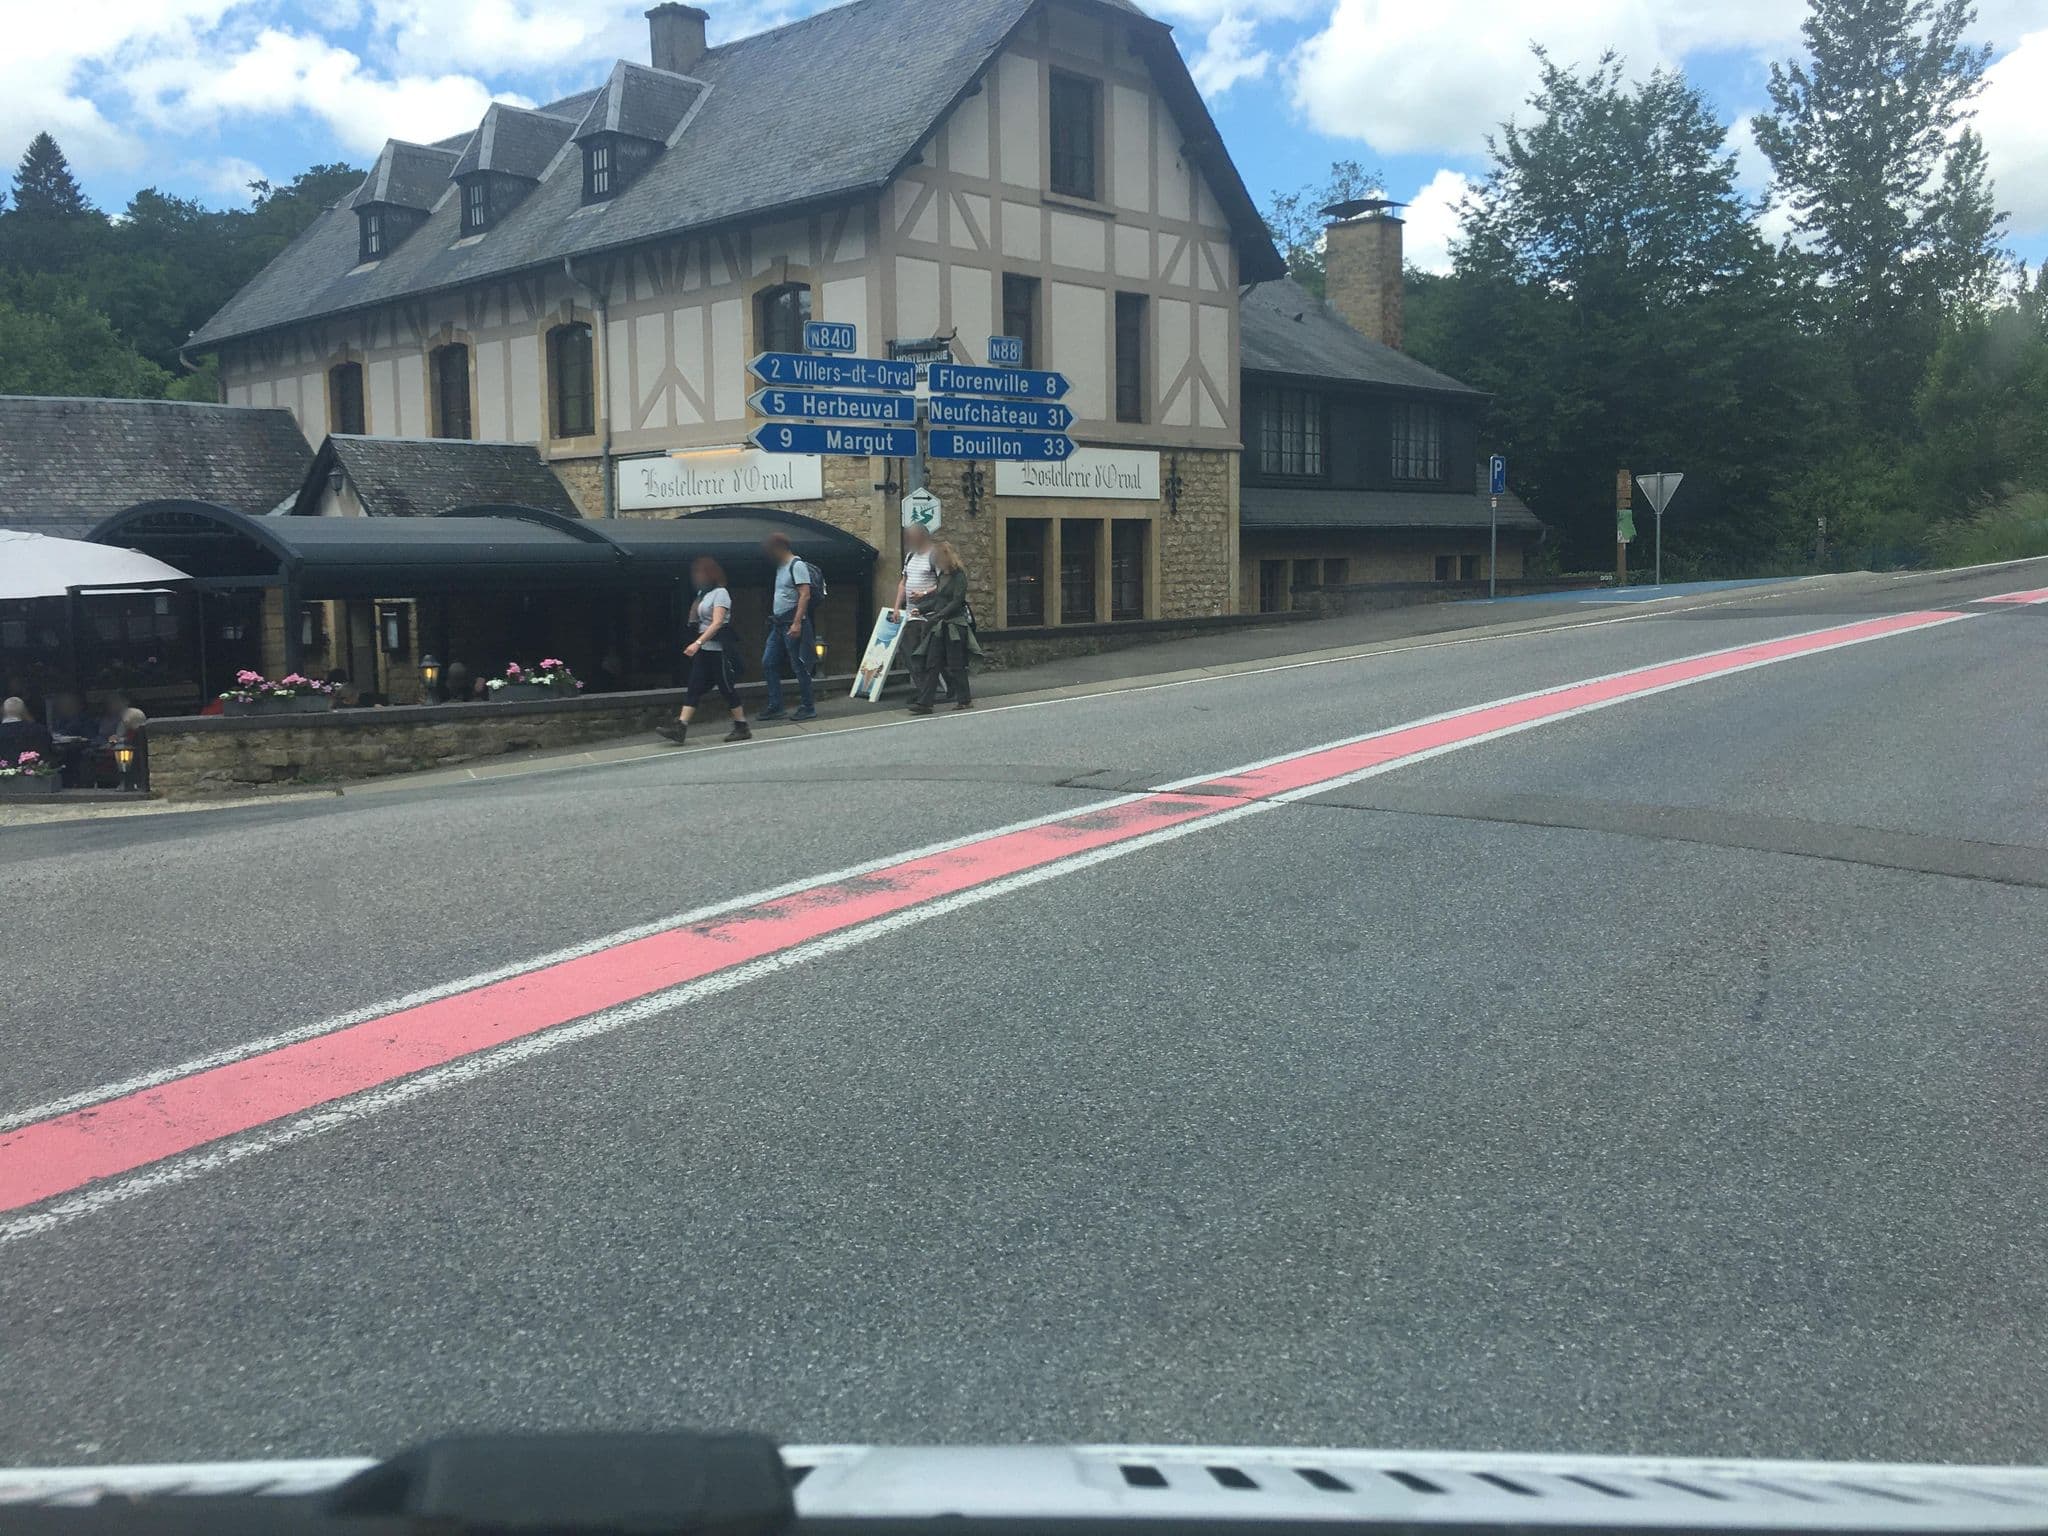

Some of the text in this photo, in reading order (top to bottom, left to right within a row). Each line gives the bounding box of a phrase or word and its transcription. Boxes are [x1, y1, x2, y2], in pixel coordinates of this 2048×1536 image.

[811, 328, 851, 349] N840
[992, 342, 1018, 360] N88
[771, 359, 781, 379] 2
[793, 360, 914, 386] Villers-dt-Orval
[939, 369, 1029, 393] Florenville
[1046, 377, 1056, 393] 8
[773, 394, 899, 419] 5 Herbeuval
[931, 397, 1065, 425] Neufchâteau 31
[780, 428, 894, 456] 9 Margut
[953, 435, 1065, 456] Bouillon 33
[641, 461, 794, 499] Hostellerie d'Orval
[1022, 460, 1142, 490] Hostellerie d'Orval
[1494, 459, 1502, 480] P
